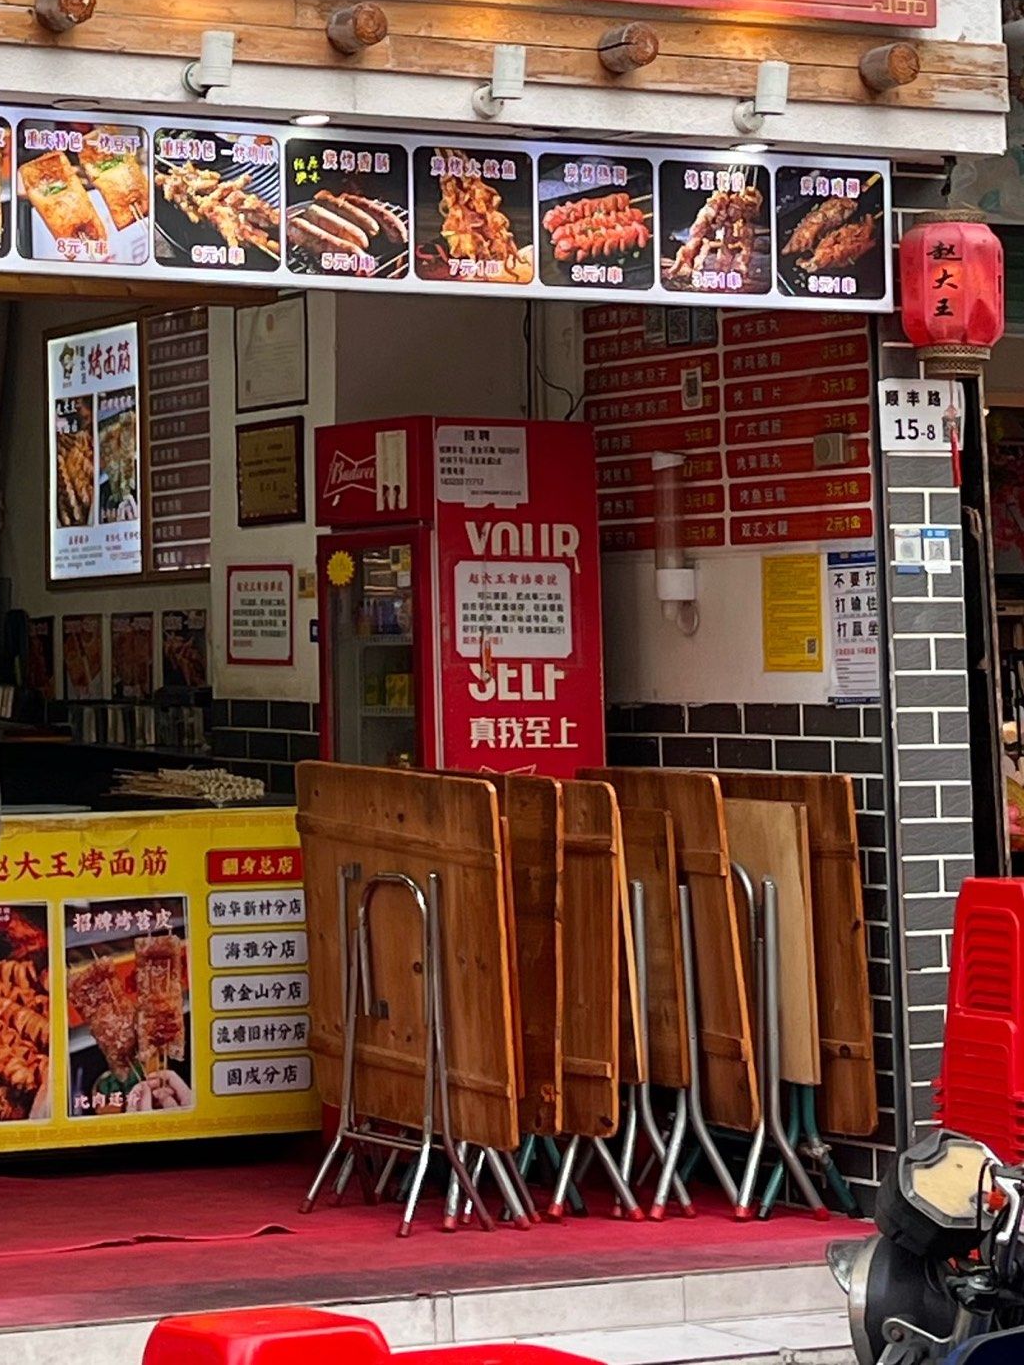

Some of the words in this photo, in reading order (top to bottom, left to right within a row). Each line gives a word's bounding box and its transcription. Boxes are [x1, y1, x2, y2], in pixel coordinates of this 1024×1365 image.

[57, 239, 109, 257] 8元1串
[191, 245, 246, 266] 9元1串
[321, 252, 377, 274] 5元1串
[448, 257, 503, 277] 7元1串
[571, 265, 624, 285] 3元1串
[691, 271, 744, 291] 3元1串
[808, 275, 858, 295] 3元1串
[926, 241, 963, 317] 赵大王
[884, 390, 942, 408] 顺丰路
[894, 418, 936, 441] 15-8
[468, 715, 579, 750] 真我至上
[213, 897, 302, 917] 怡华新村分店
[72, 908, 173, 933] 招牌烤苕皮
[224, 939, 297, 961] 海雅分店
[221, 978, 303, 1001] 黄金山分店
[216, 1022, 307, 1045] 流塘旧村分店
